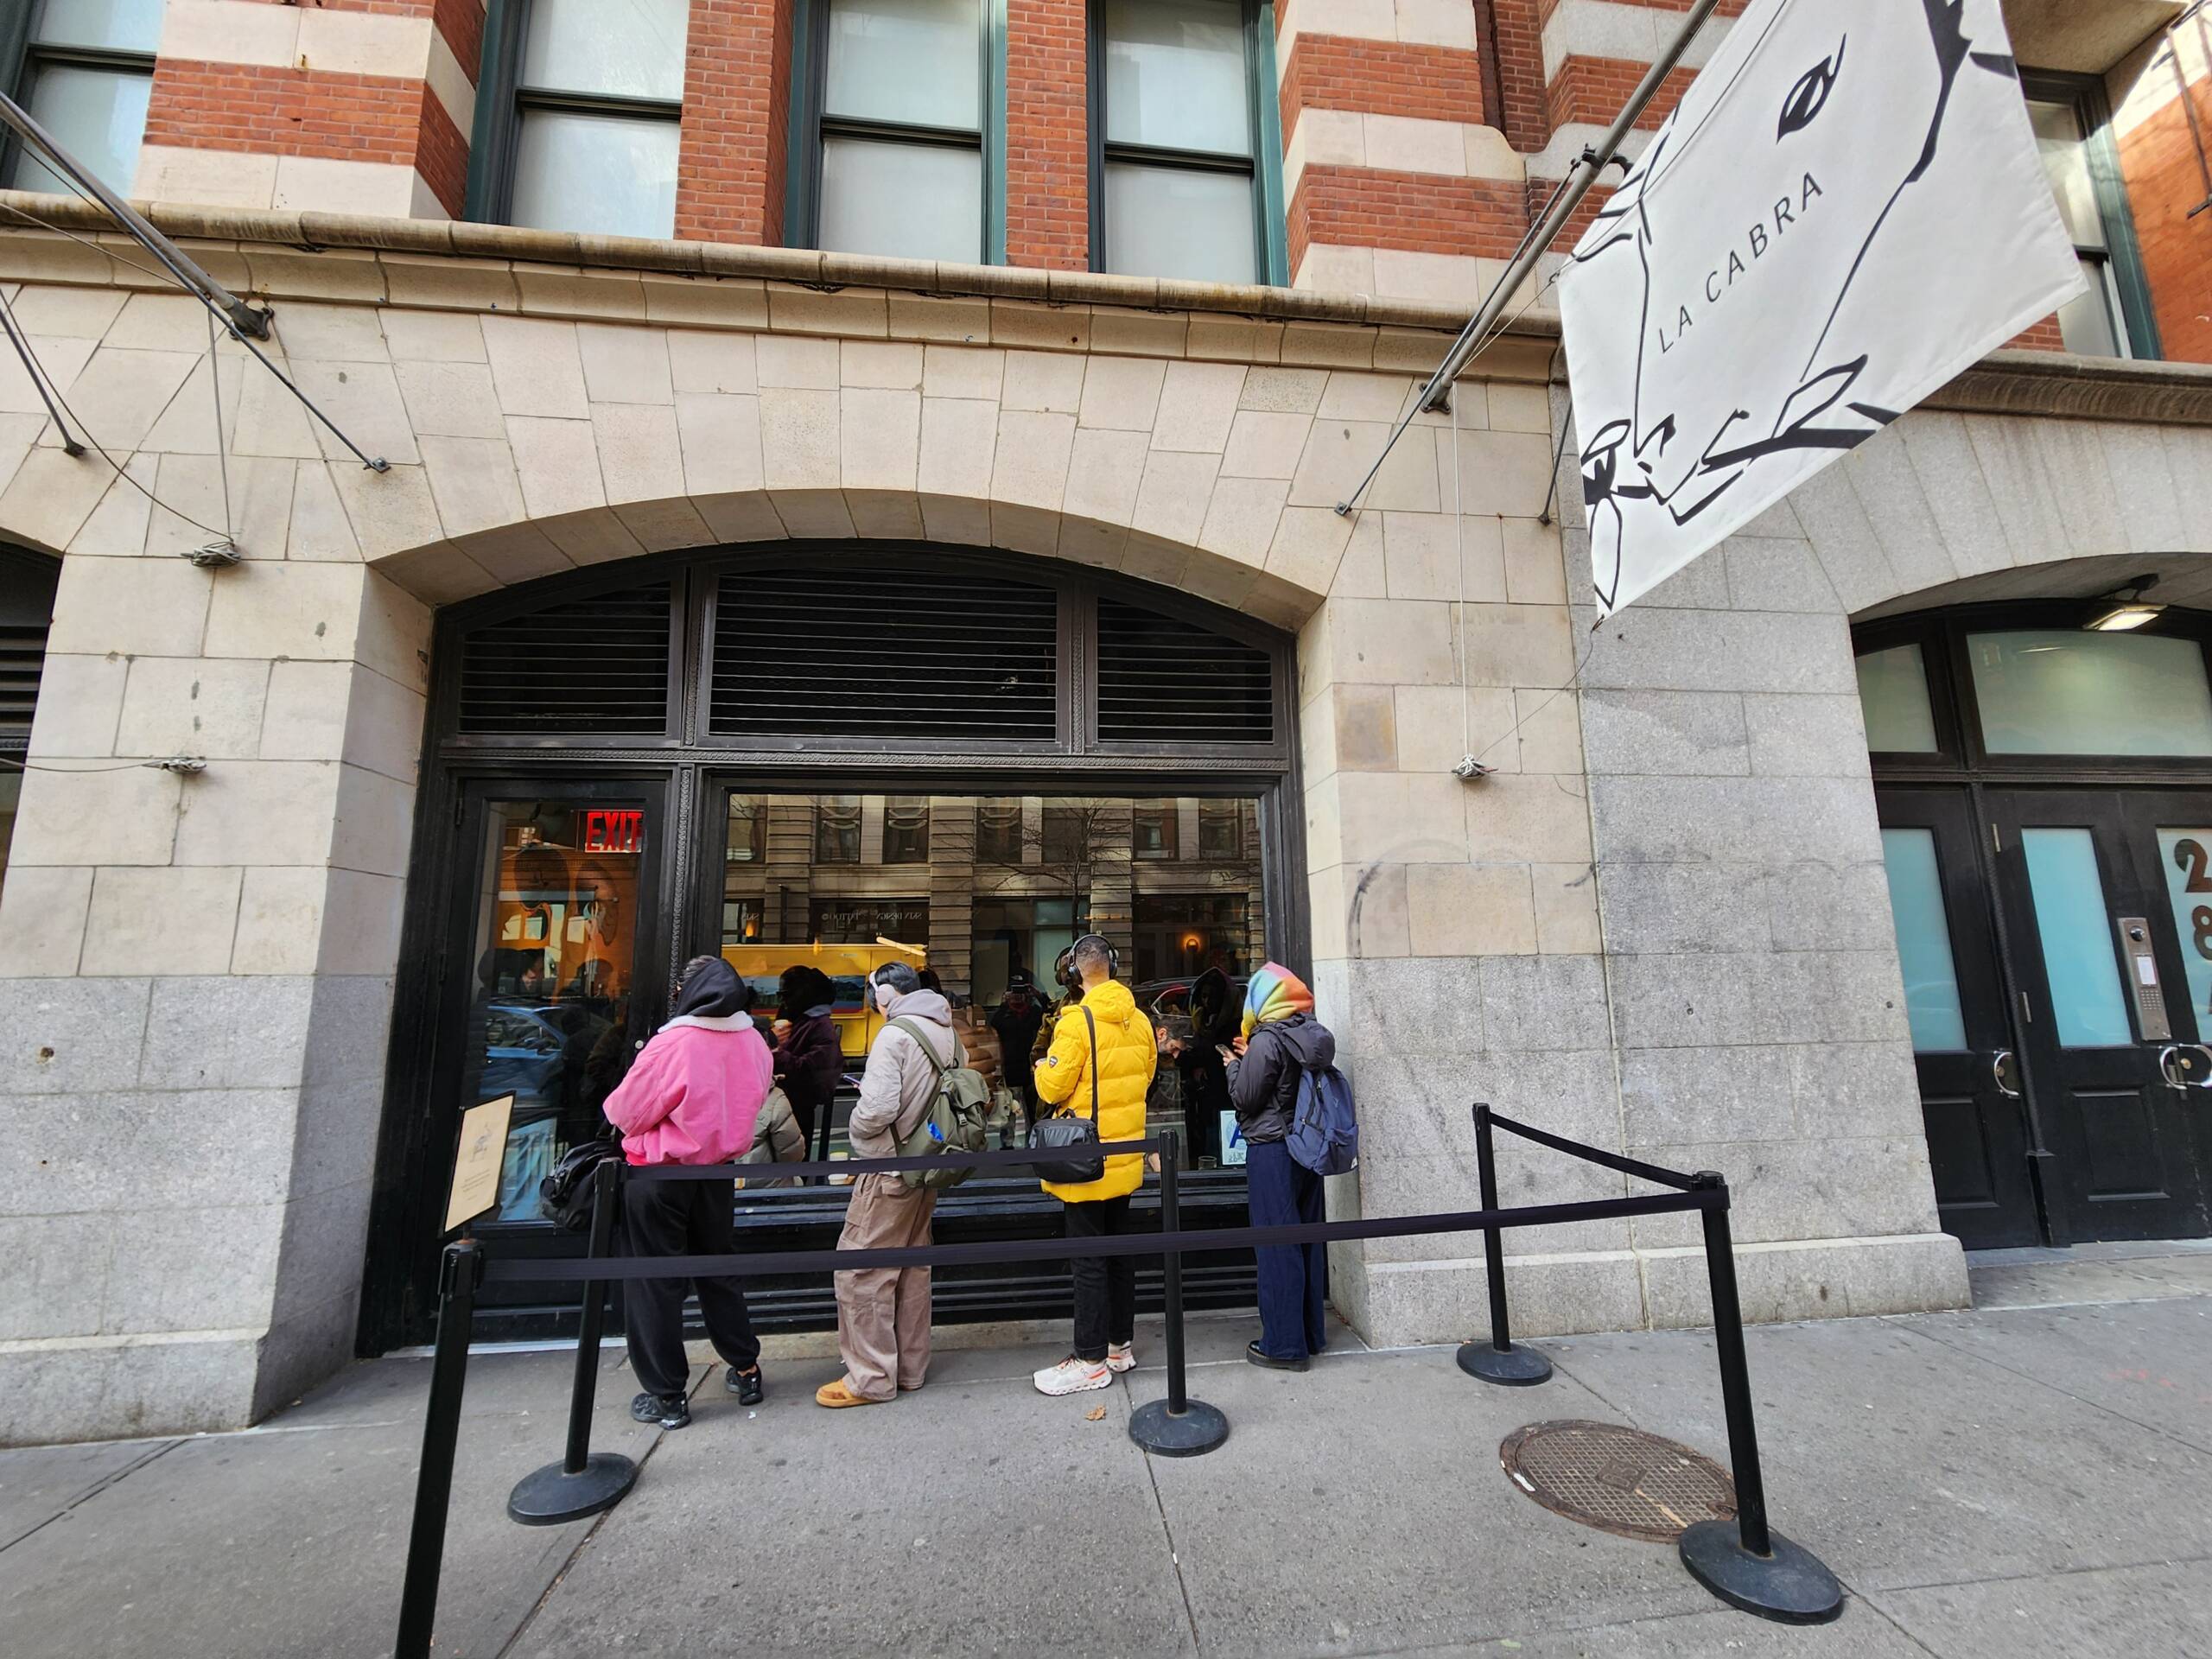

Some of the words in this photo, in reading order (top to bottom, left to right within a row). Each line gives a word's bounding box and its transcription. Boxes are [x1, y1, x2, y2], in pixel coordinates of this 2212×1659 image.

[1659, 304, 1694, 354] LA
[1706, 171, 1823, 302] CABRA
[587, 811, 643, 852] EXIT
